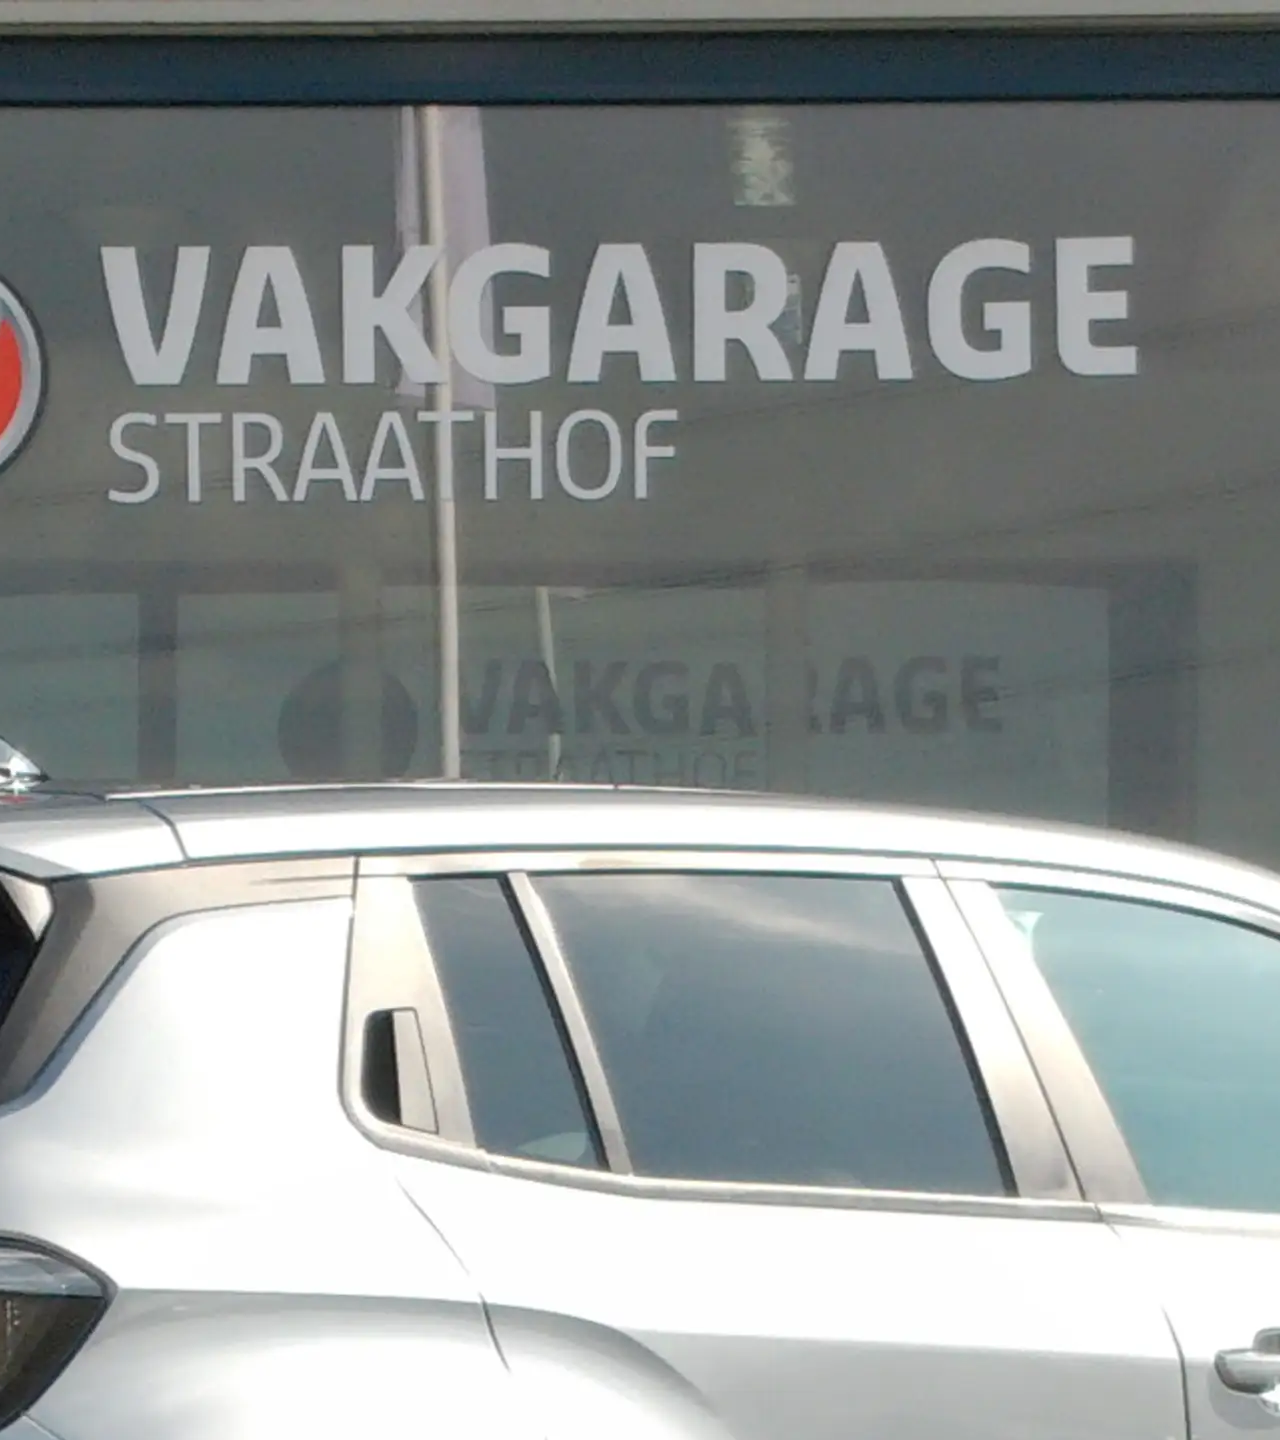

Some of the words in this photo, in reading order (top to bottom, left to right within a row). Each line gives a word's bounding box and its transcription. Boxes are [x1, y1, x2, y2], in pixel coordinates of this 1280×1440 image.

[100, 236, 1139, 386] VAKGARAGE
[108, 409, 679, 504] STRAATHOF
[458, 655, 1004, 737] VAKGAAGE
